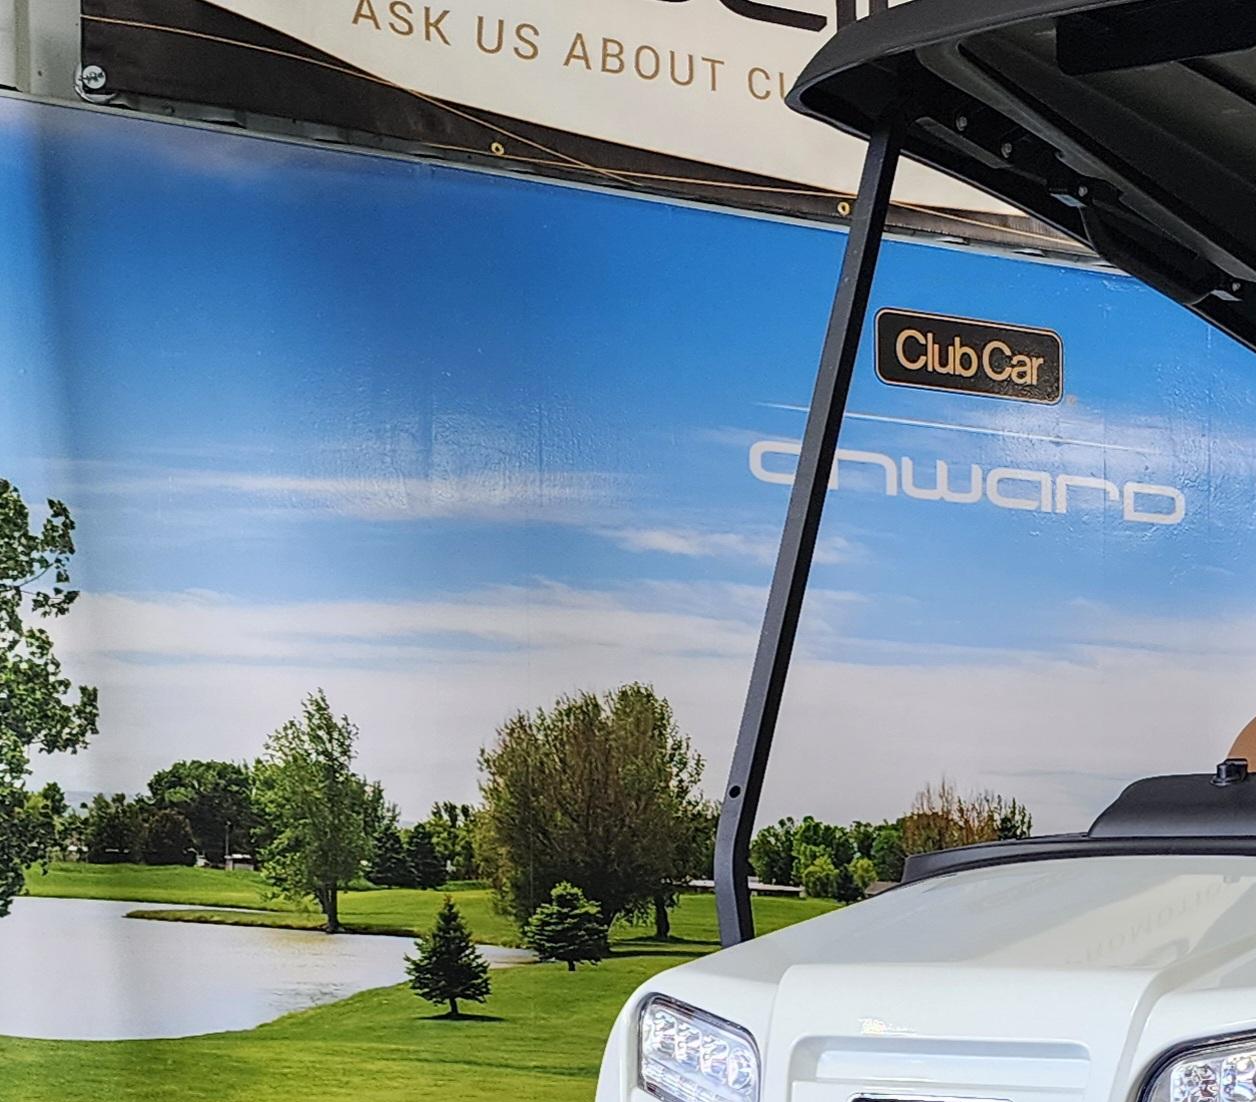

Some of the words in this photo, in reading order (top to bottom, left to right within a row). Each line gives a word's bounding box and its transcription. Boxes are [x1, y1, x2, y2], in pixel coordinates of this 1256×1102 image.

[352, 0, 452, 46] ASK
[476, 15, 540, 61] US
[563, 32, 725, 92] ABOUT
[895, 328, 979, 379] Club
[981, 340, 1045, 386] Car
